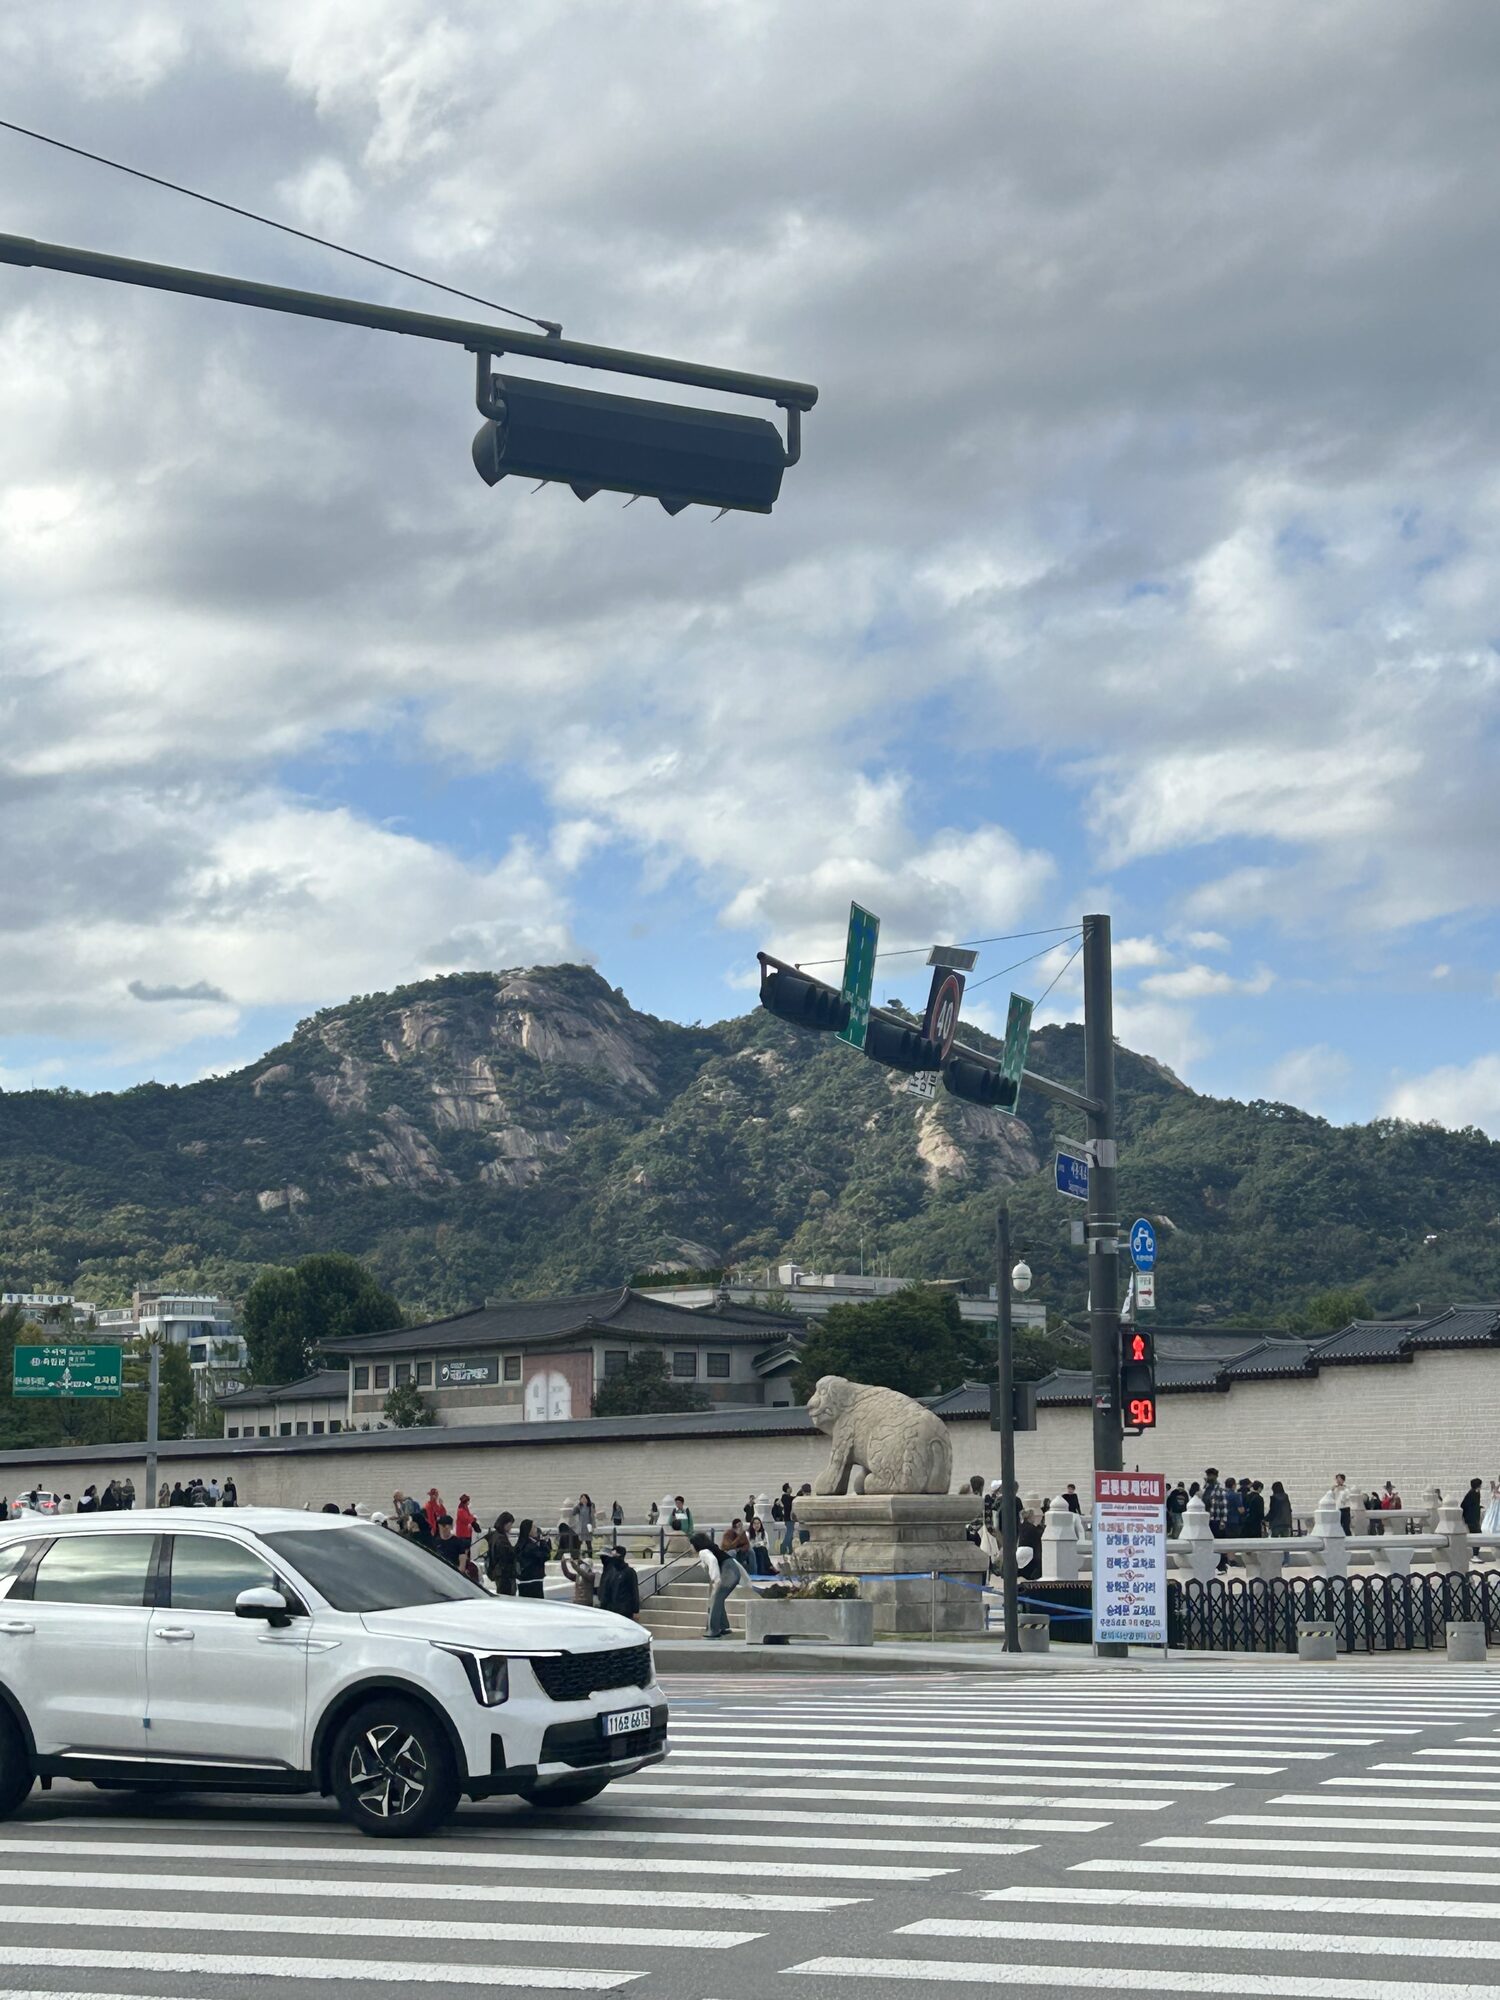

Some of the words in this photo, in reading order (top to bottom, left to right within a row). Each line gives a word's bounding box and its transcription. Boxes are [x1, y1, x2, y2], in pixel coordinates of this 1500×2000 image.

[937, 1000, 954, 1039] 40
[1131, 1400, 1152, 1423] 90
[1132, 1535, 1155, 1546] 삼거리
[1132, 1558, 1155, 1569] 교차로
[1106, 1581, 1129, 1593] 광화문
[1132, 1581, 1155, 1593] 삼거리
[1132, 1605, 1156, 1616] 교차로
